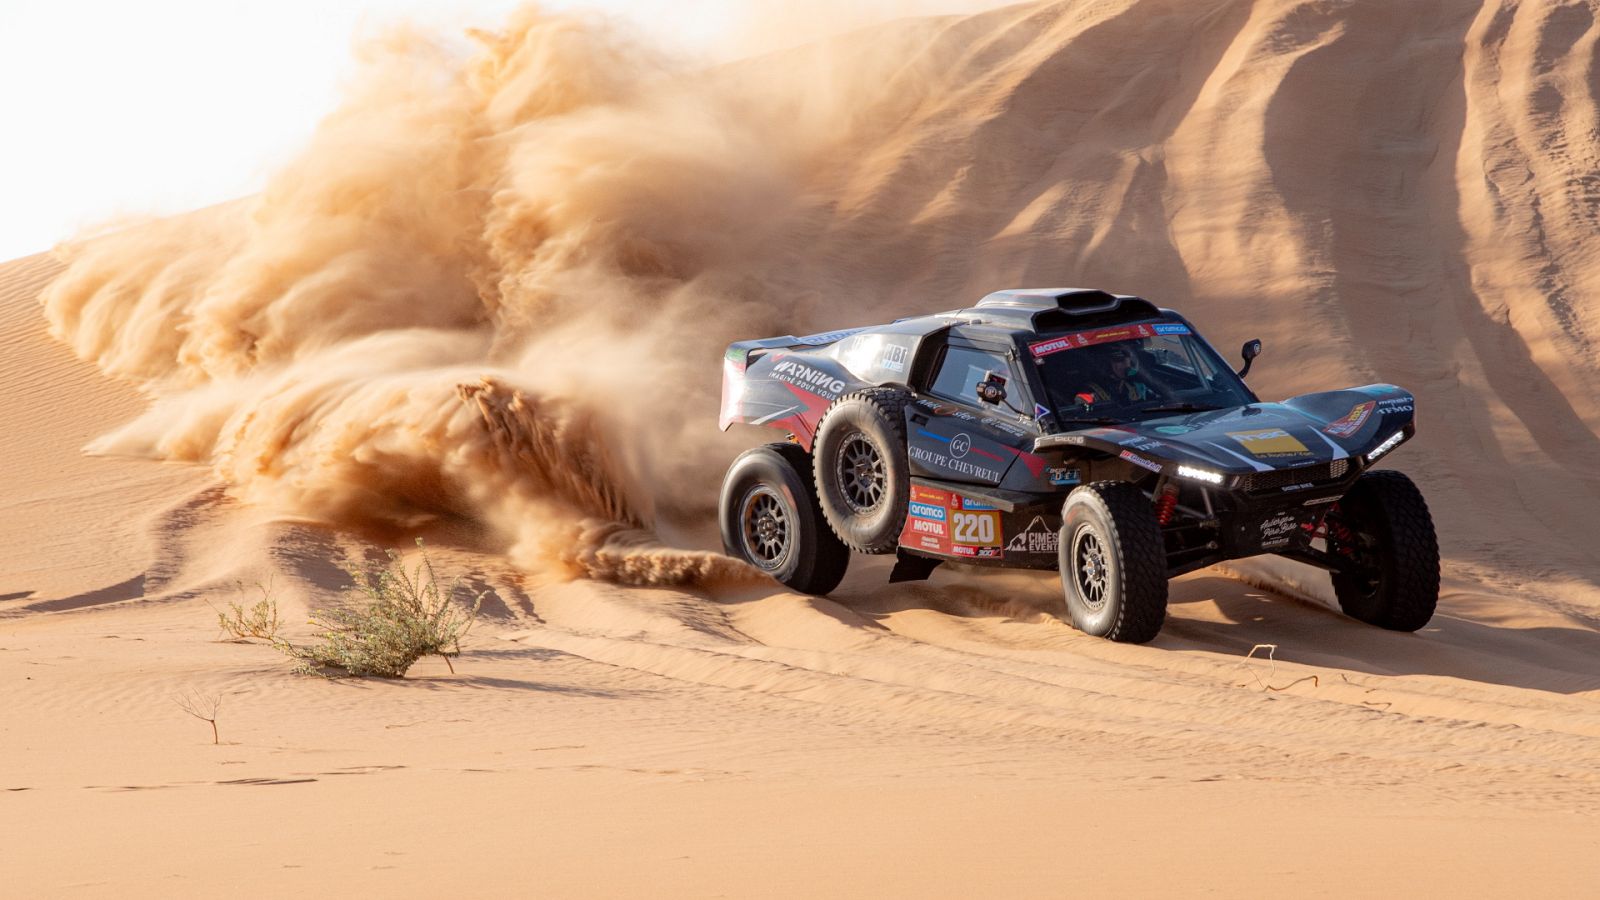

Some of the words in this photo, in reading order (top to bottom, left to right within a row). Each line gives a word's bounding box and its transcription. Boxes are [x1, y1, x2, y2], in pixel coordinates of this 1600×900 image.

[1034, 340, 1069, 354] MOTUL
[796, 380, 816, 392] POUR
[817, 389, 837, 401] VOUS
[952, 439, 968, 452] GC
[908, 445, 948, 467] GROUPE
[948, 458, 1001, 483] CHEVREUL
[911, 504, 944, 518] aramco
[913, 520, 944, 534] MOTUL
[953, 512, 995, 543] 220
[1029, 532, 1058, 543] CIMES
[953, 546, 975, 554] MOTUL
